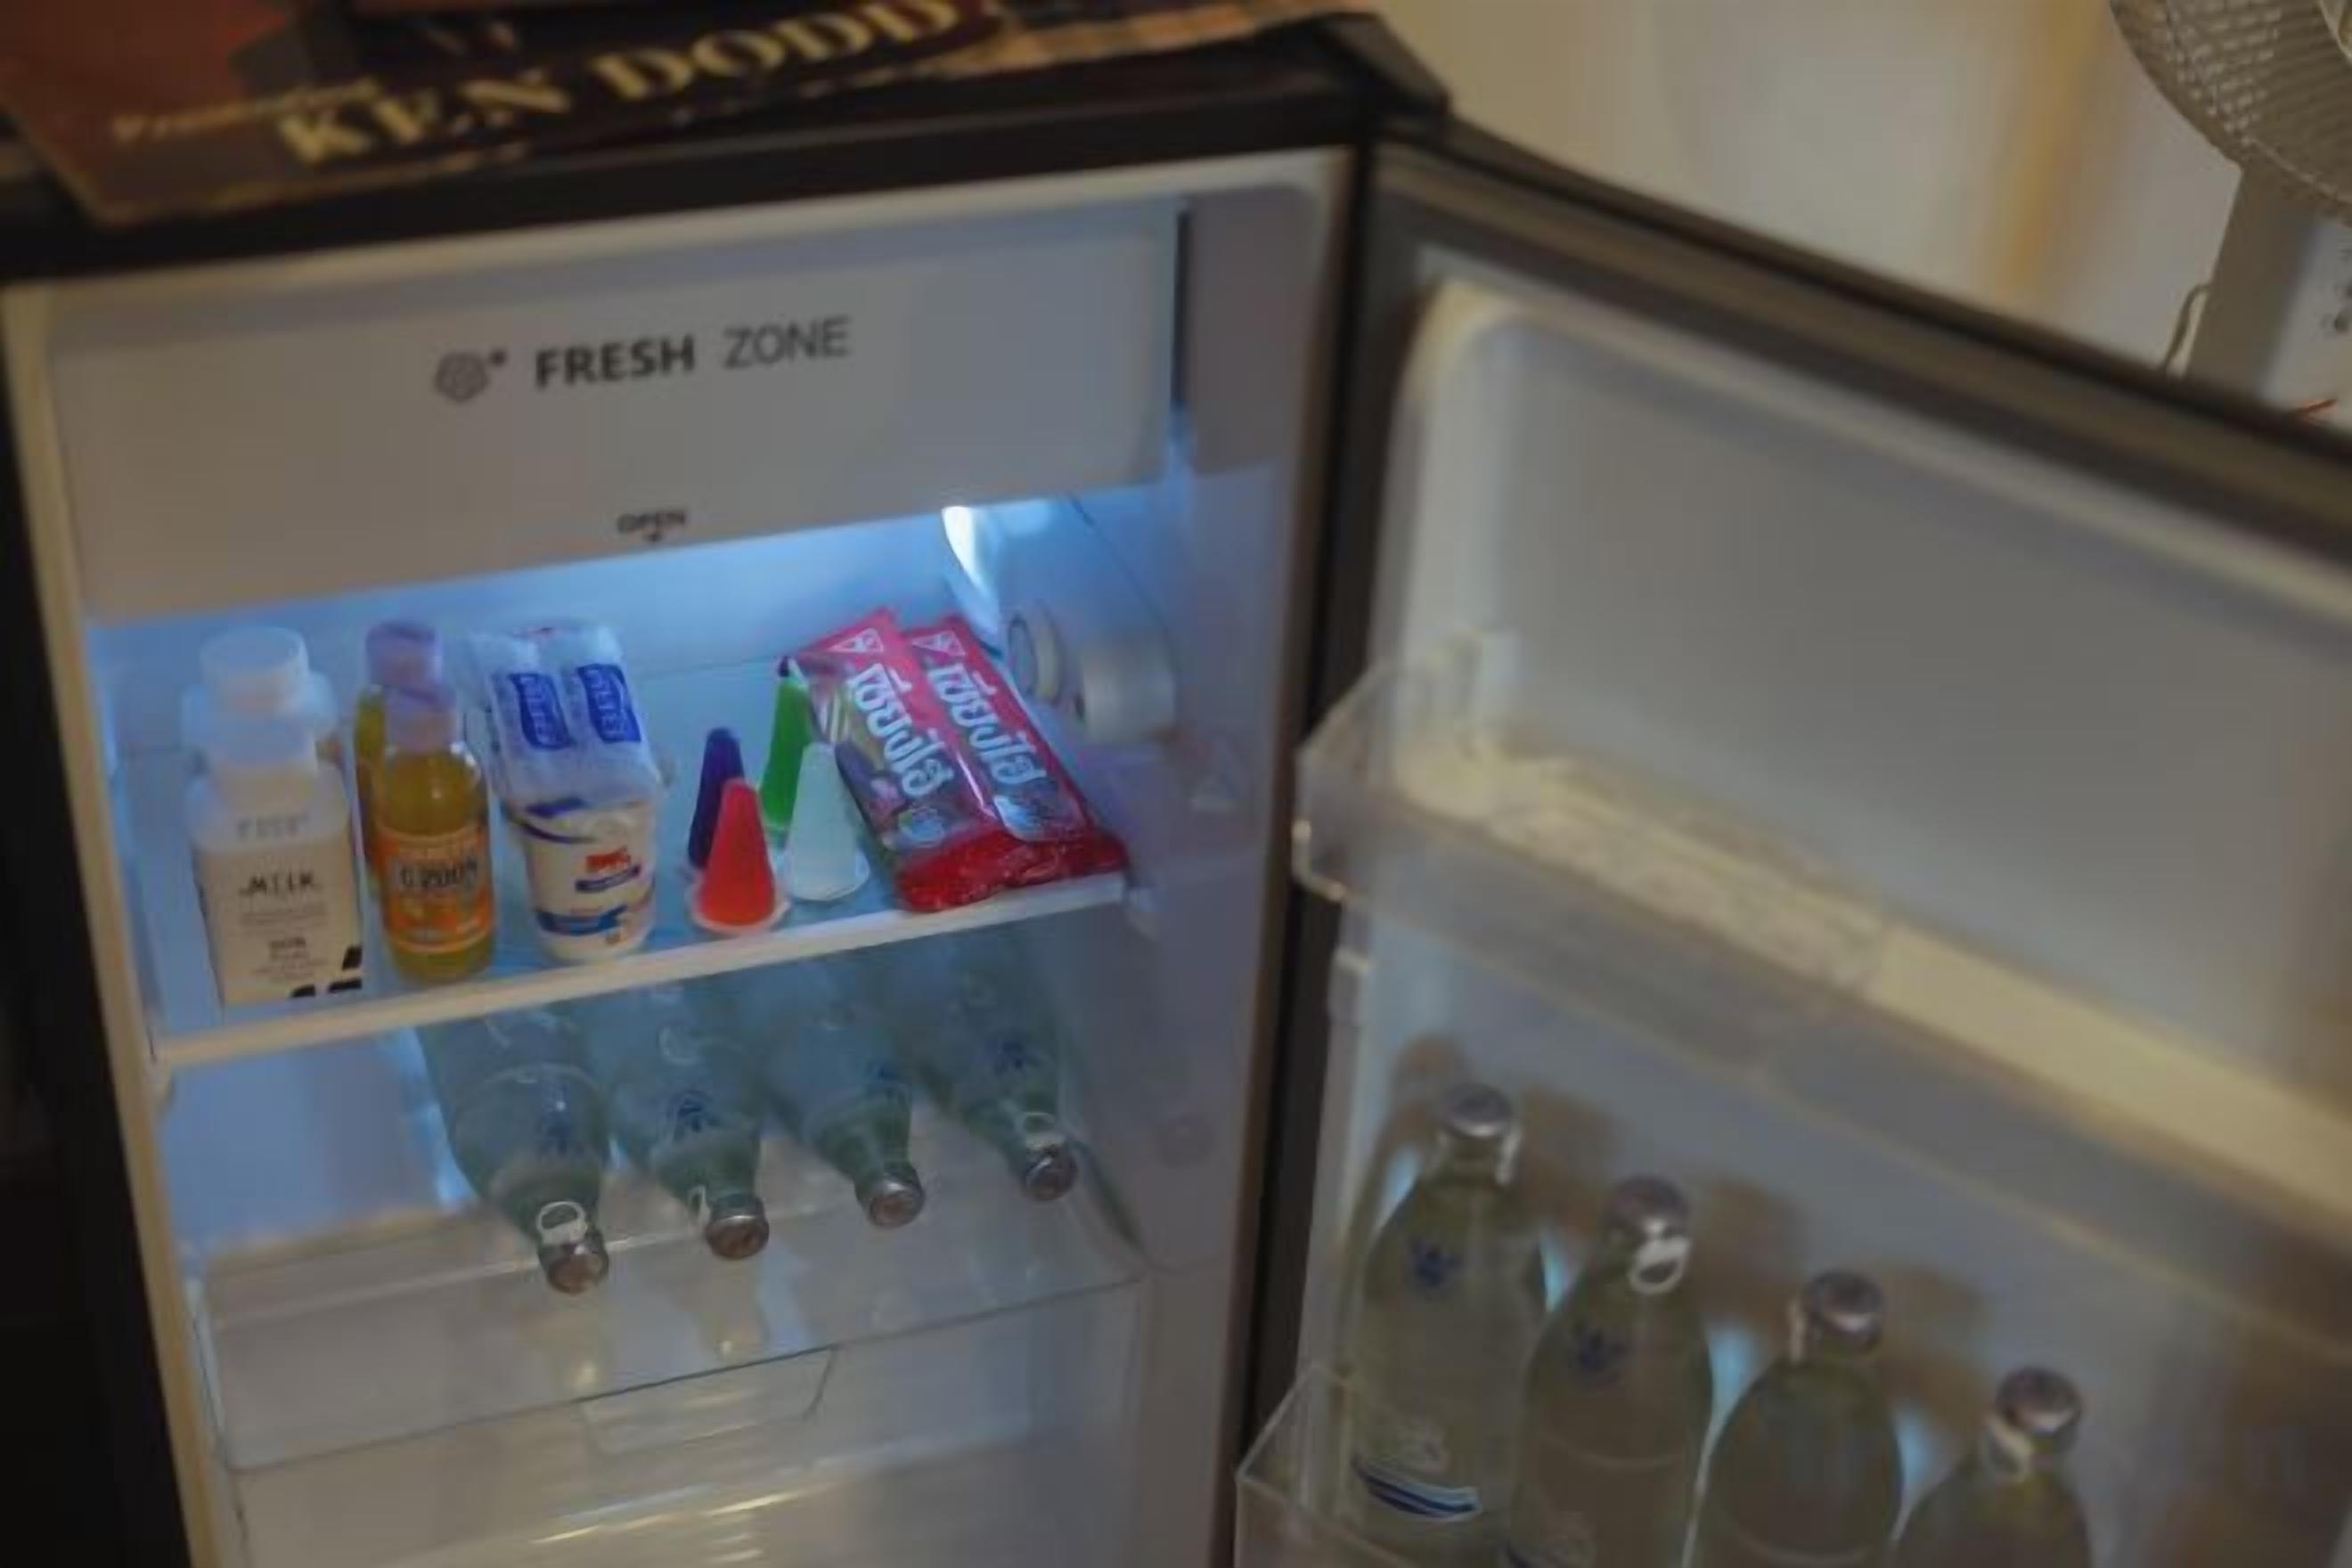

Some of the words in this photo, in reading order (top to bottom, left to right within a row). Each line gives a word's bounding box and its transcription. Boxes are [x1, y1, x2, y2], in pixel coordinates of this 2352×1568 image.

[279, 71, 572, 164] KEN
[592, 0, 960, 100] DODD
[535, 335, 696, 389] FRESH
[723, 315, 850, 369] ZONE
[617, 509, 687, 535] OPEN
[241, 871, 315, 896] MILK
